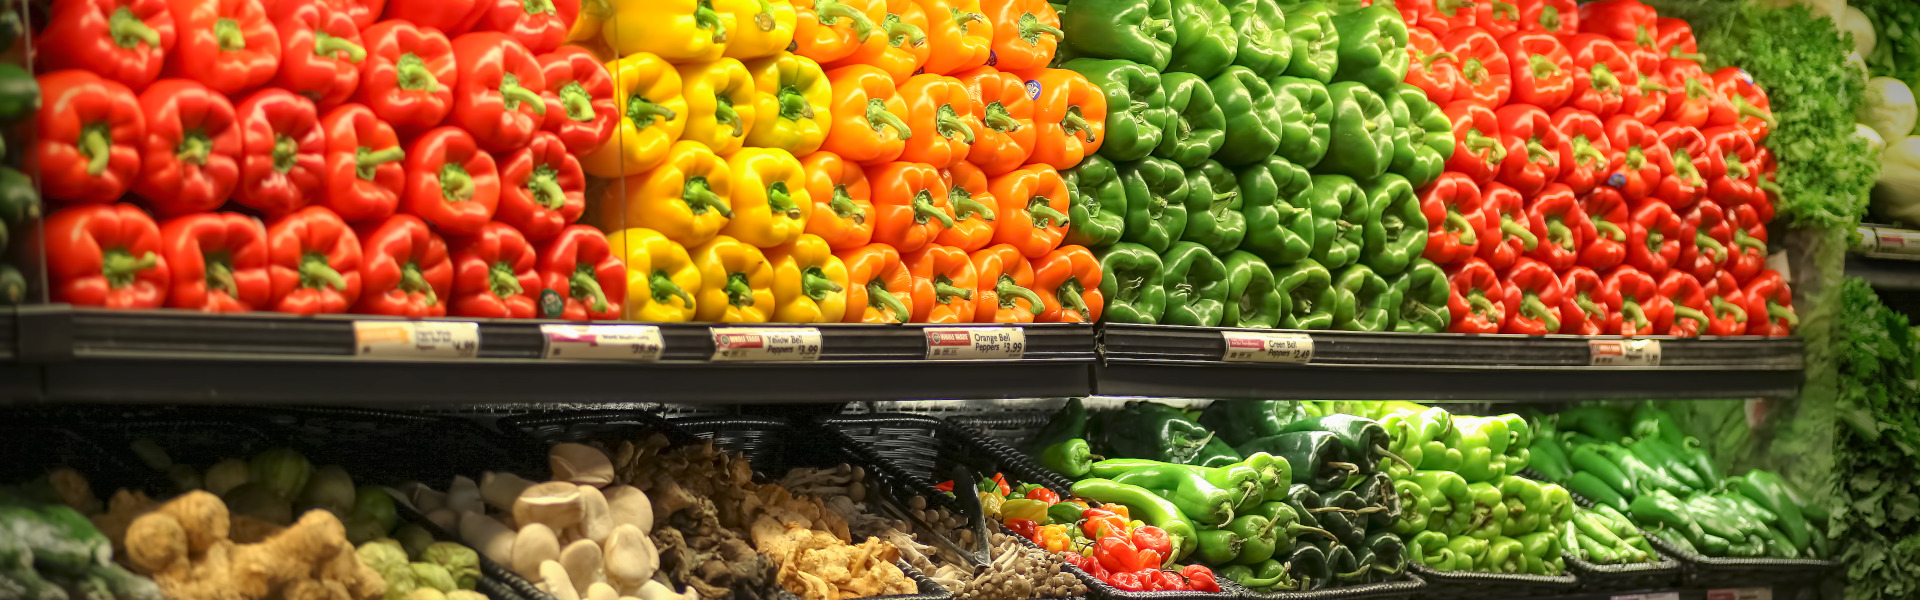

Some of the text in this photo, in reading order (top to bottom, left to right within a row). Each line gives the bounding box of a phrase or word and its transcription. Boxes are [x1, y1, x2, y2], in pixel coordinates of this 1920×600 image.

[767, 334, 804, 344] Yellow Bell
[974, 332, 1011, 345] Orange Bell
[767, 344, 819, 355] Peppers $3.99
[975, 342, 1023, 353] Peppers $3.99
[1268, 340, 1286, 348] Green
[1286, 340, 1298, 349] Bell
[1268, 348, 1310, 359] Peppers $2.49
